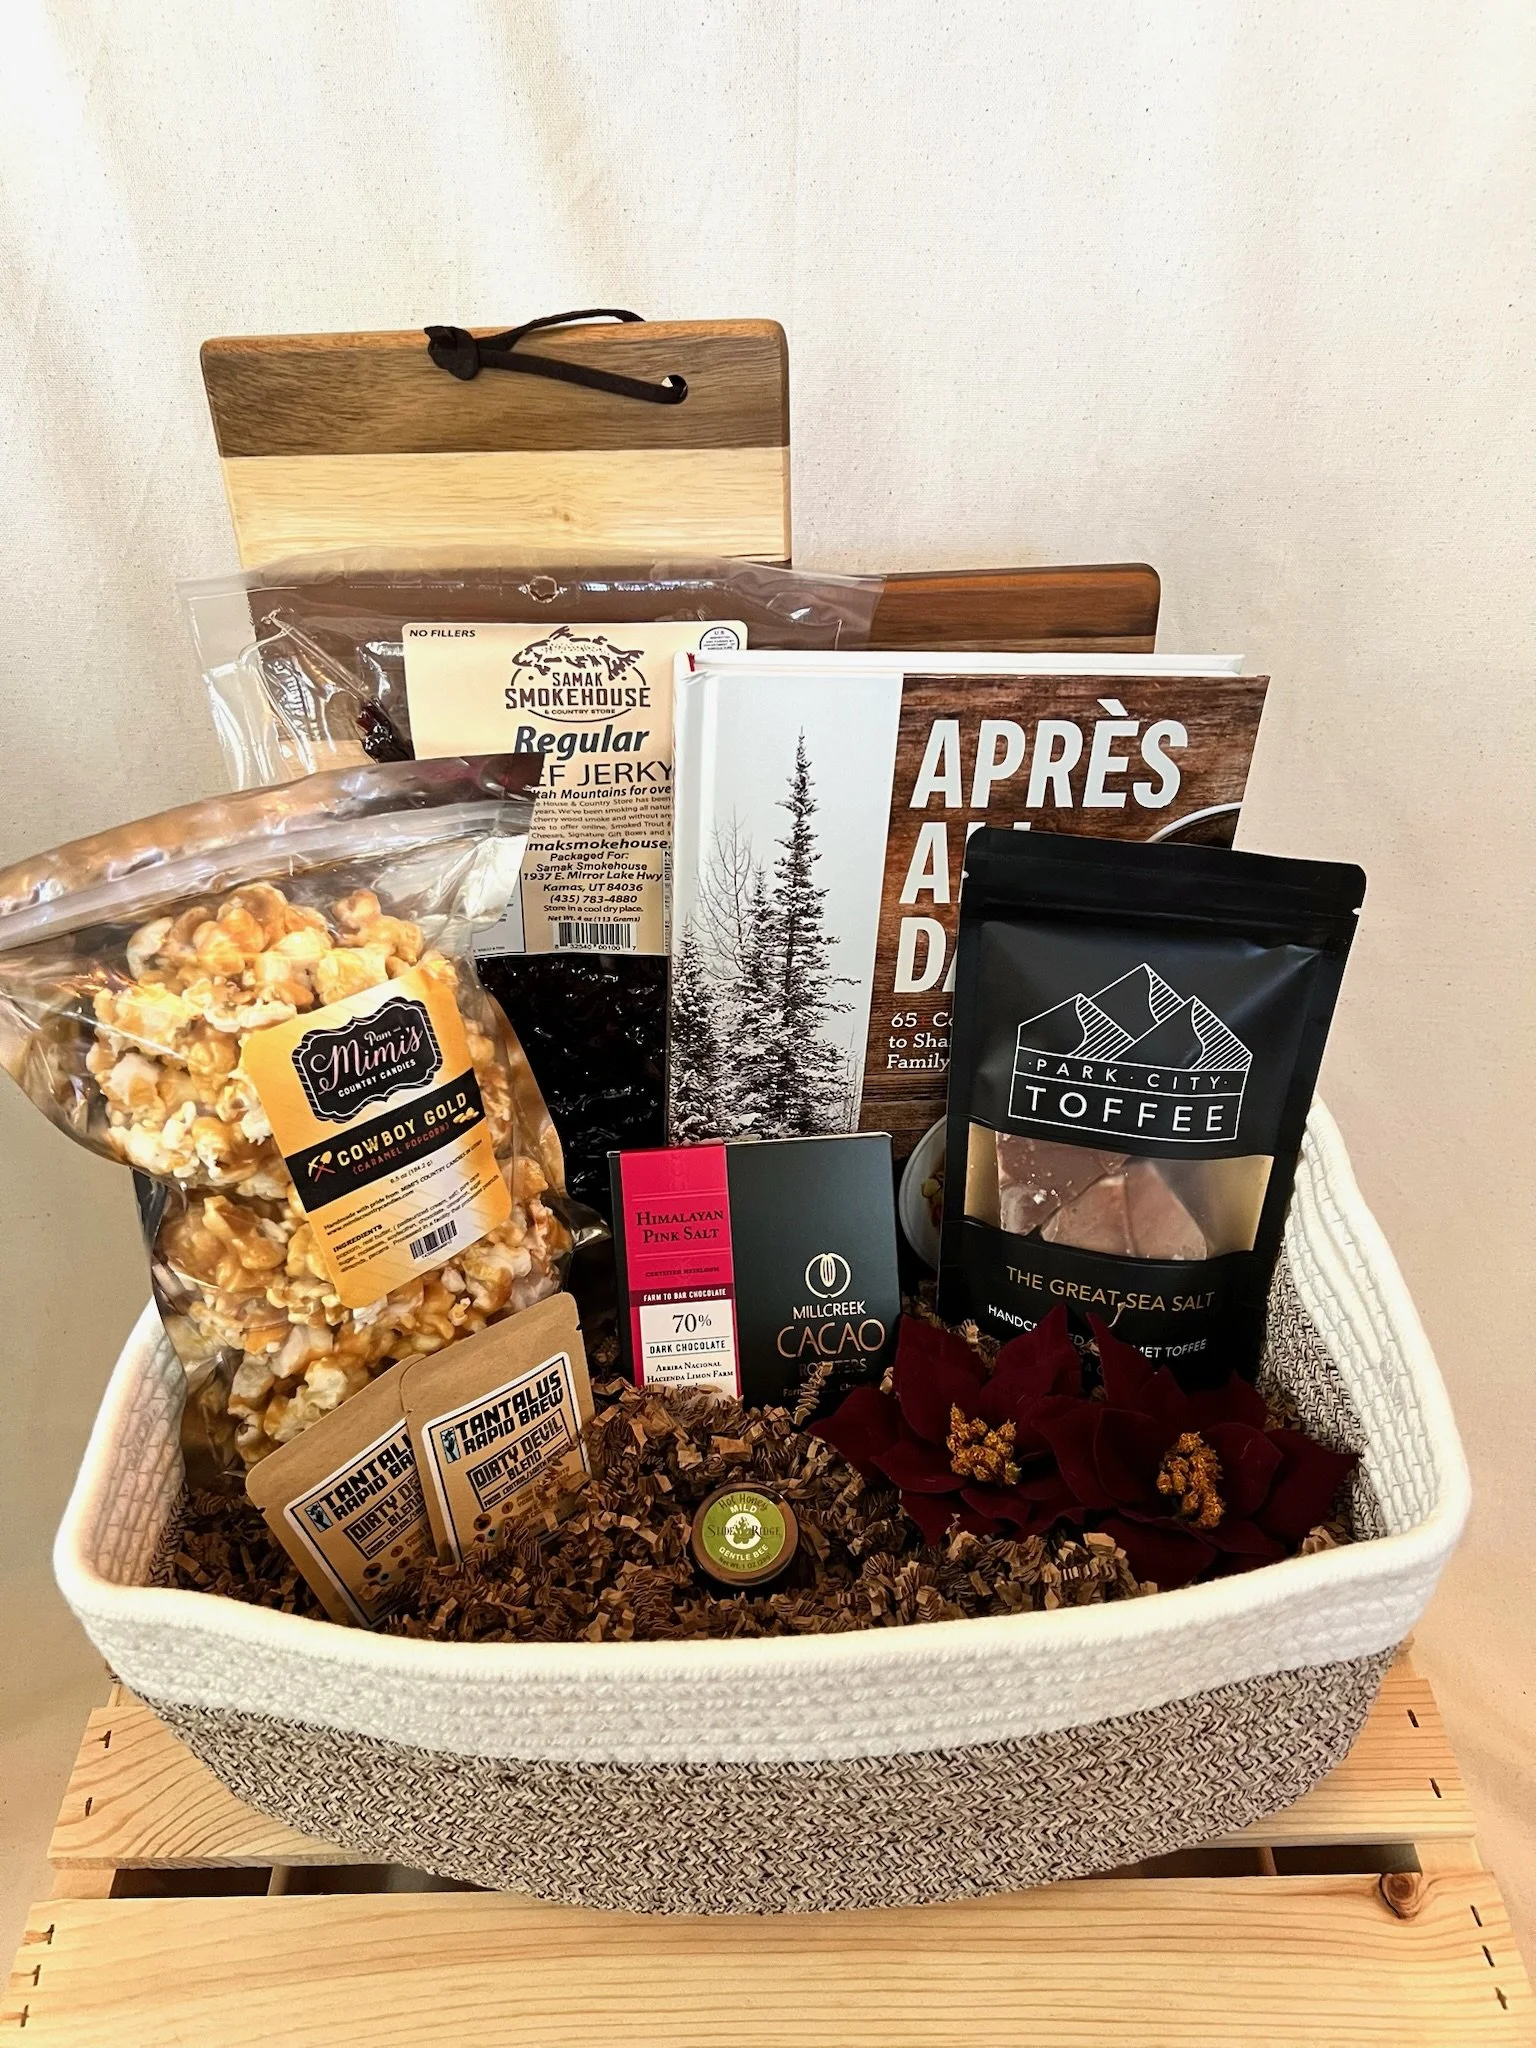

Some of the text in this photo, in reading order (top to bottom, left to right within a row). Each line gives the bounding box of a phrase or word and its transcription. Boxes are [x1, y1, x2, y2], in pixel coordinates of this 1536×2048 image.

[409, 629, 476, 638] NO FILLERS
[552, 672, 603, 687] SAMAK
[505, 687, 651, 710] SMOKEHOUSE
[514, 725, 650, 761] Regular
[909, 698, 1189, 809] APRÈS
[577, 761, 672, 787] JERKY
[533, 785, 672, 800] tah Mountains for ove
[526, 838, 671, 851] maksmokehouse.
[568, 831, 605, 839] Signature
[550, 851, 629, 862] Packaged For:
[523, 872, 663, 881] 1937 E. Mirror Lake Hwy
[536, 861, 648, 873] Samak Smokehouse
[543, 883, 644, 892] Kamas, UT 84036
[550, 895, 638, 904] (435) 783-4880
[603, 906, 618, 914] dry
[619, 905, 644, 914] place.
[364, 1030, 392, 1047] Pam
[888, 1032, 952, 1048] to Sha
[310, 1025, 424, 1095] Mimi's
[886, 1052, 951, 1072] Family
[338, 1058, 417, 1098] COUNTRY CANDIES
[1037, 1058, 1222, 1090] PARK CITY
[1025, 1085, 1224, 1133] TOFFEE
[337, 1092, 467, 1167] COWBOY GOLD
[352, 1148, 402, 1175] (CARAMEL
[323, 1210, 356, 1230] Handmade
[355, 1203, 370, 1214] with
[368, 1195, 386, 1209] pride
[384, 1188, 400, 1200] from
[418, 1165, 446, 1183] COUNTRY
[444, 1152, 467, 1168] CANDIES
[636, 1210, 724, 1226] HIMALAYAN
[331, 1223, 383, 1253] INGREDIENTS
[643, 1226, 720, 1244] PINK SALT
[643, 1293, 662, 1302] FARM
[673, 1292, 687, 1300] BAR
[689, 1288, 727, 1299] CHOCOLATE
[1006, 1265, 1216, 1312] THE GREAT SEA SALT
[793, 1300, 866, 1320] MILLCREEK
[672, 1313, 712, 1334] 70%
[649, 1339, 726, 1355] DARK CHOCOLATE
[777, 1319, 886, 1358] CACAO
[1164, 1339, 1208, 1358] TOFFEE
[684, 1361, 722, 1370] NACIONAL
[800, 1358, 867, 1377] ROTERS
[646, 1370, 734, 1384] HACIENDA LIMON FARM
[455, 1370, 562, 1441] TANTALUS
[463, 1417, 516, 1456] RAPID
[518, 1387, 564, 1427] BREW
[472, 1445, 519, 1488] DIRTY
[520, 1416, 563, 1452] DEVIL
[320, 1433, 413, 1510] TANTAL
[507, 1450, 542, 1481] BLEND
[332, 1474, 389, 1521] RAPID
[387, 1449, 416, 1480] BR
[718, 1493, 769, 1511] Hot Honey
[730, 1503, 758, 1514] MILD
[348, 1494, 399, 1541] DIRTY
[752, 1525, 781, 1539] RIDGE
[719, 1544, 769, 1561] GENTLE BEE
